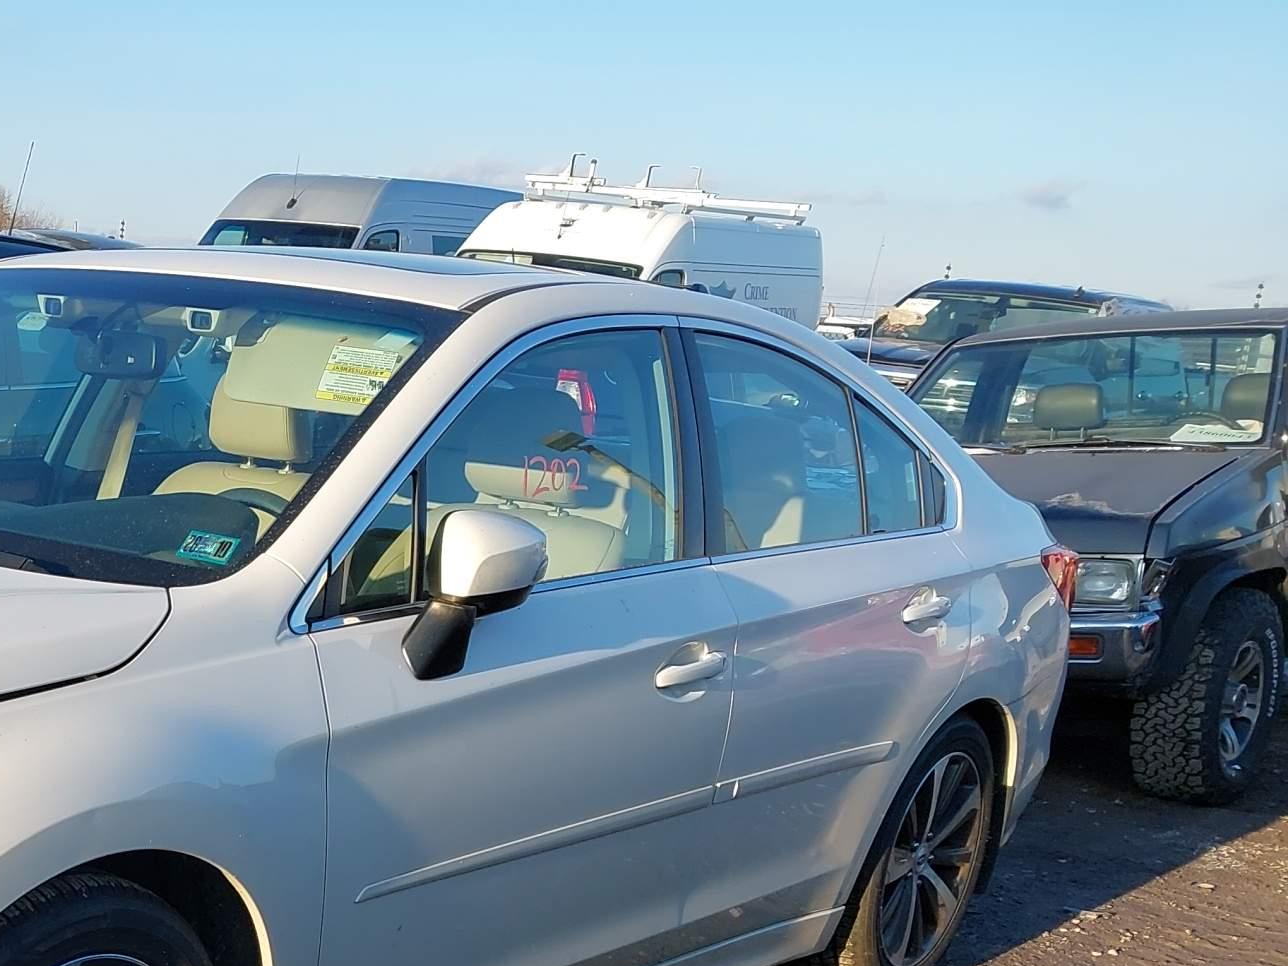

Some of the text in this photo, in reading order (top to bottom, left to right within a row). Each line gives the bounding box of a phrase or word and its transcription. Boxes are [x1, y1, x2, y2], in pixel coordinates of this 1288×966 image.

[332, 393, 361, 403] WARNING
[523, 455, 589, 497] 1202
[213, 540, 233, 558] 10
